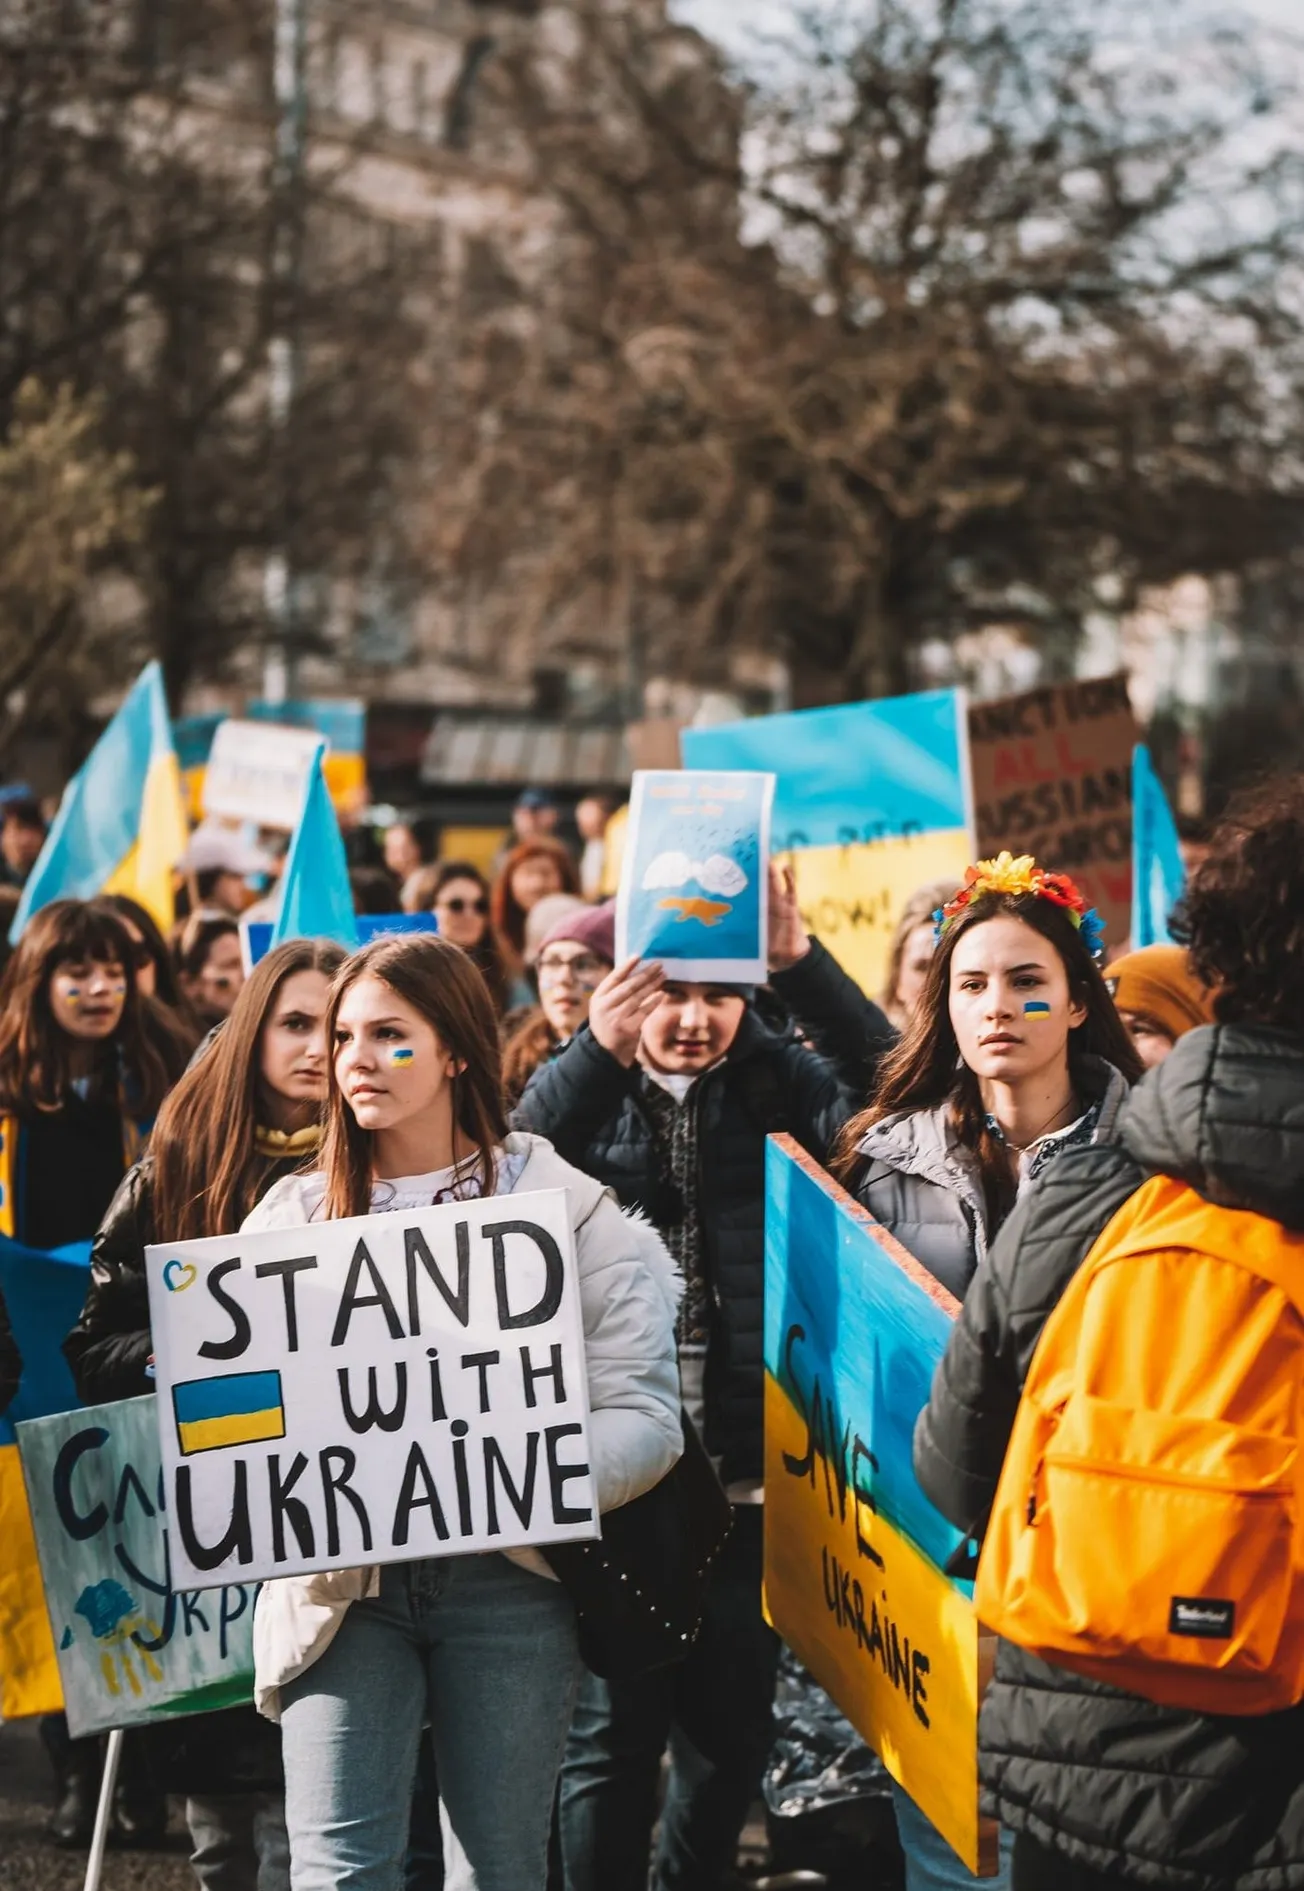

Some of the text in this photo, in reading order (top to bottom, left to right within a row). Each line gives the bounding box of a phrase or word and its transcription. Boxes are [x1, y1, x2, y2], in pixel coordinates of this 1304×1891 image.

[977, 764, 1131, 838] USSIAN
[994, 733, 1094, 787] ALL
[198, 1221, 564, 1359] STAND
[782, 1324, 885, 1572] SAVE
